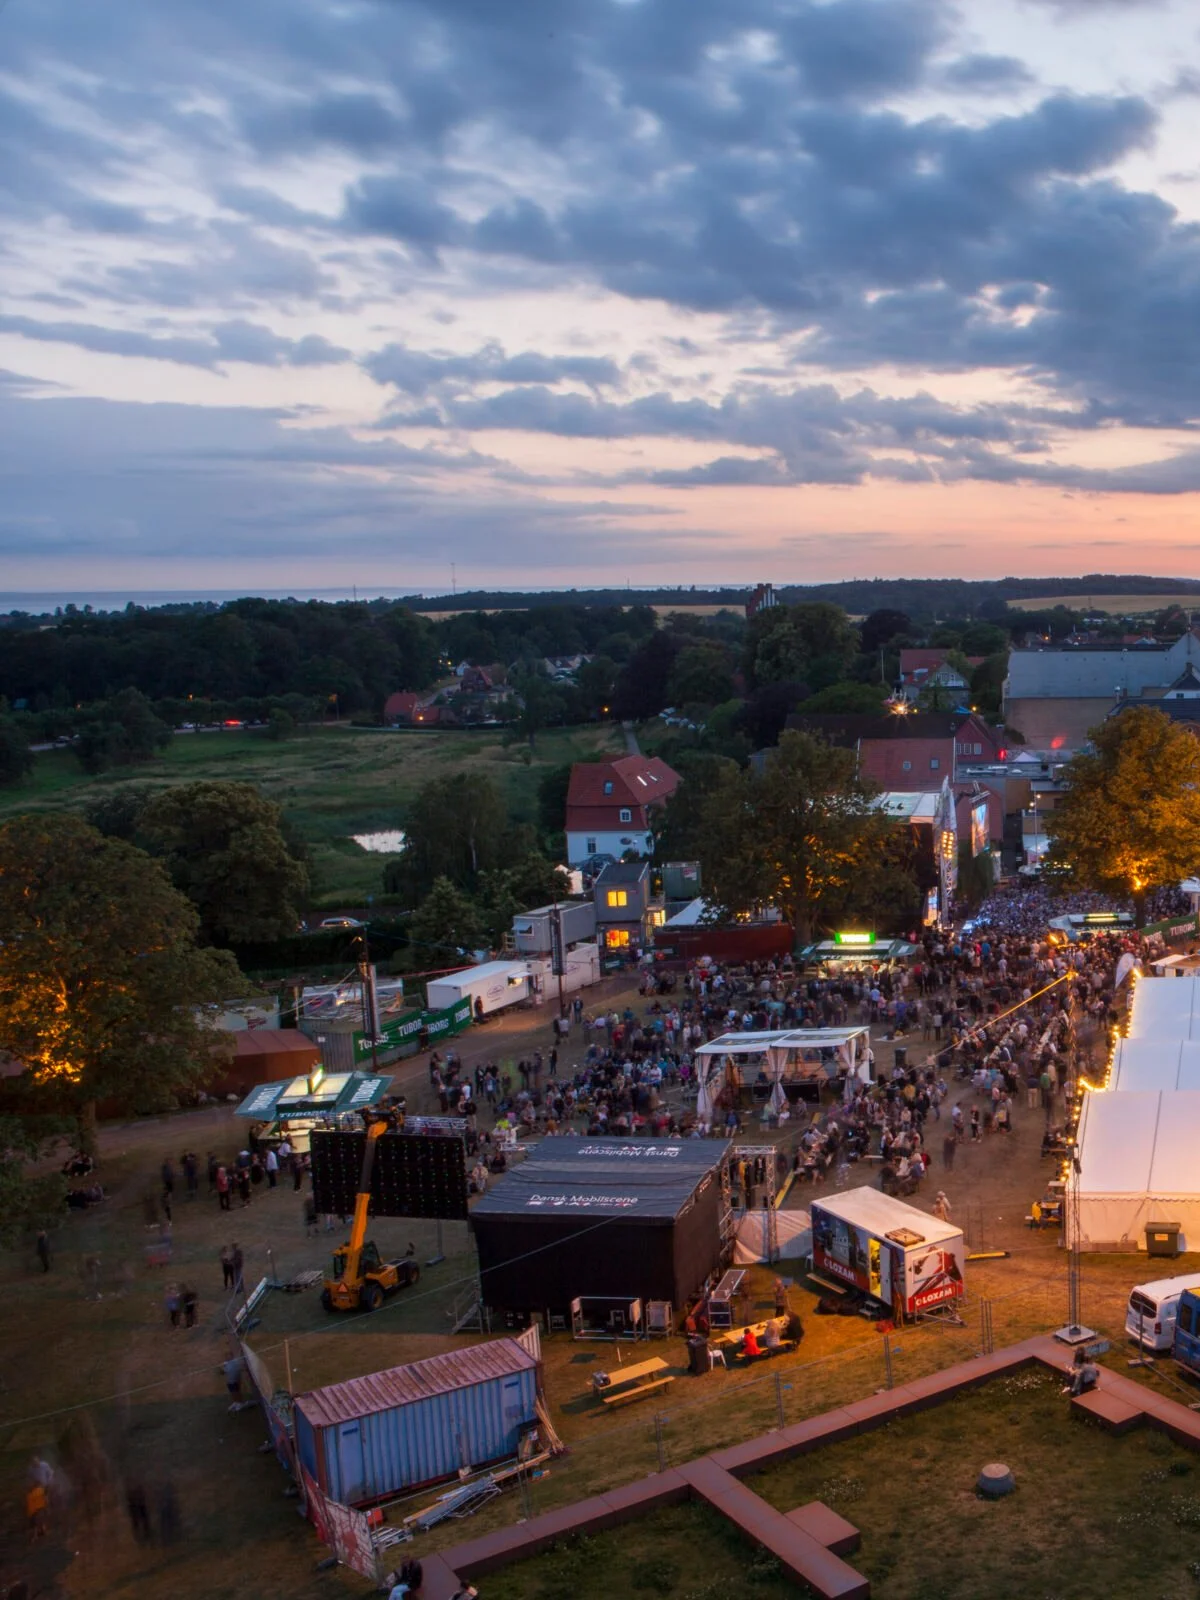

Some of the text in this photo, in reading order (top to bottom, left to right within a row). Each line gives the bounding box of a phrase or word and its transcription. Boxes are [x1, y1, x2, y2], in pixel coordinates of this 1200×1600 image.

[398, 1018, 423, 1037] TUBOR
[530, 1194, 639, 1204] Dansk Mobilscene
[829, 1260, 855, 1280] LOXAM
[922, 1287, 954, 1304] LOXAM
